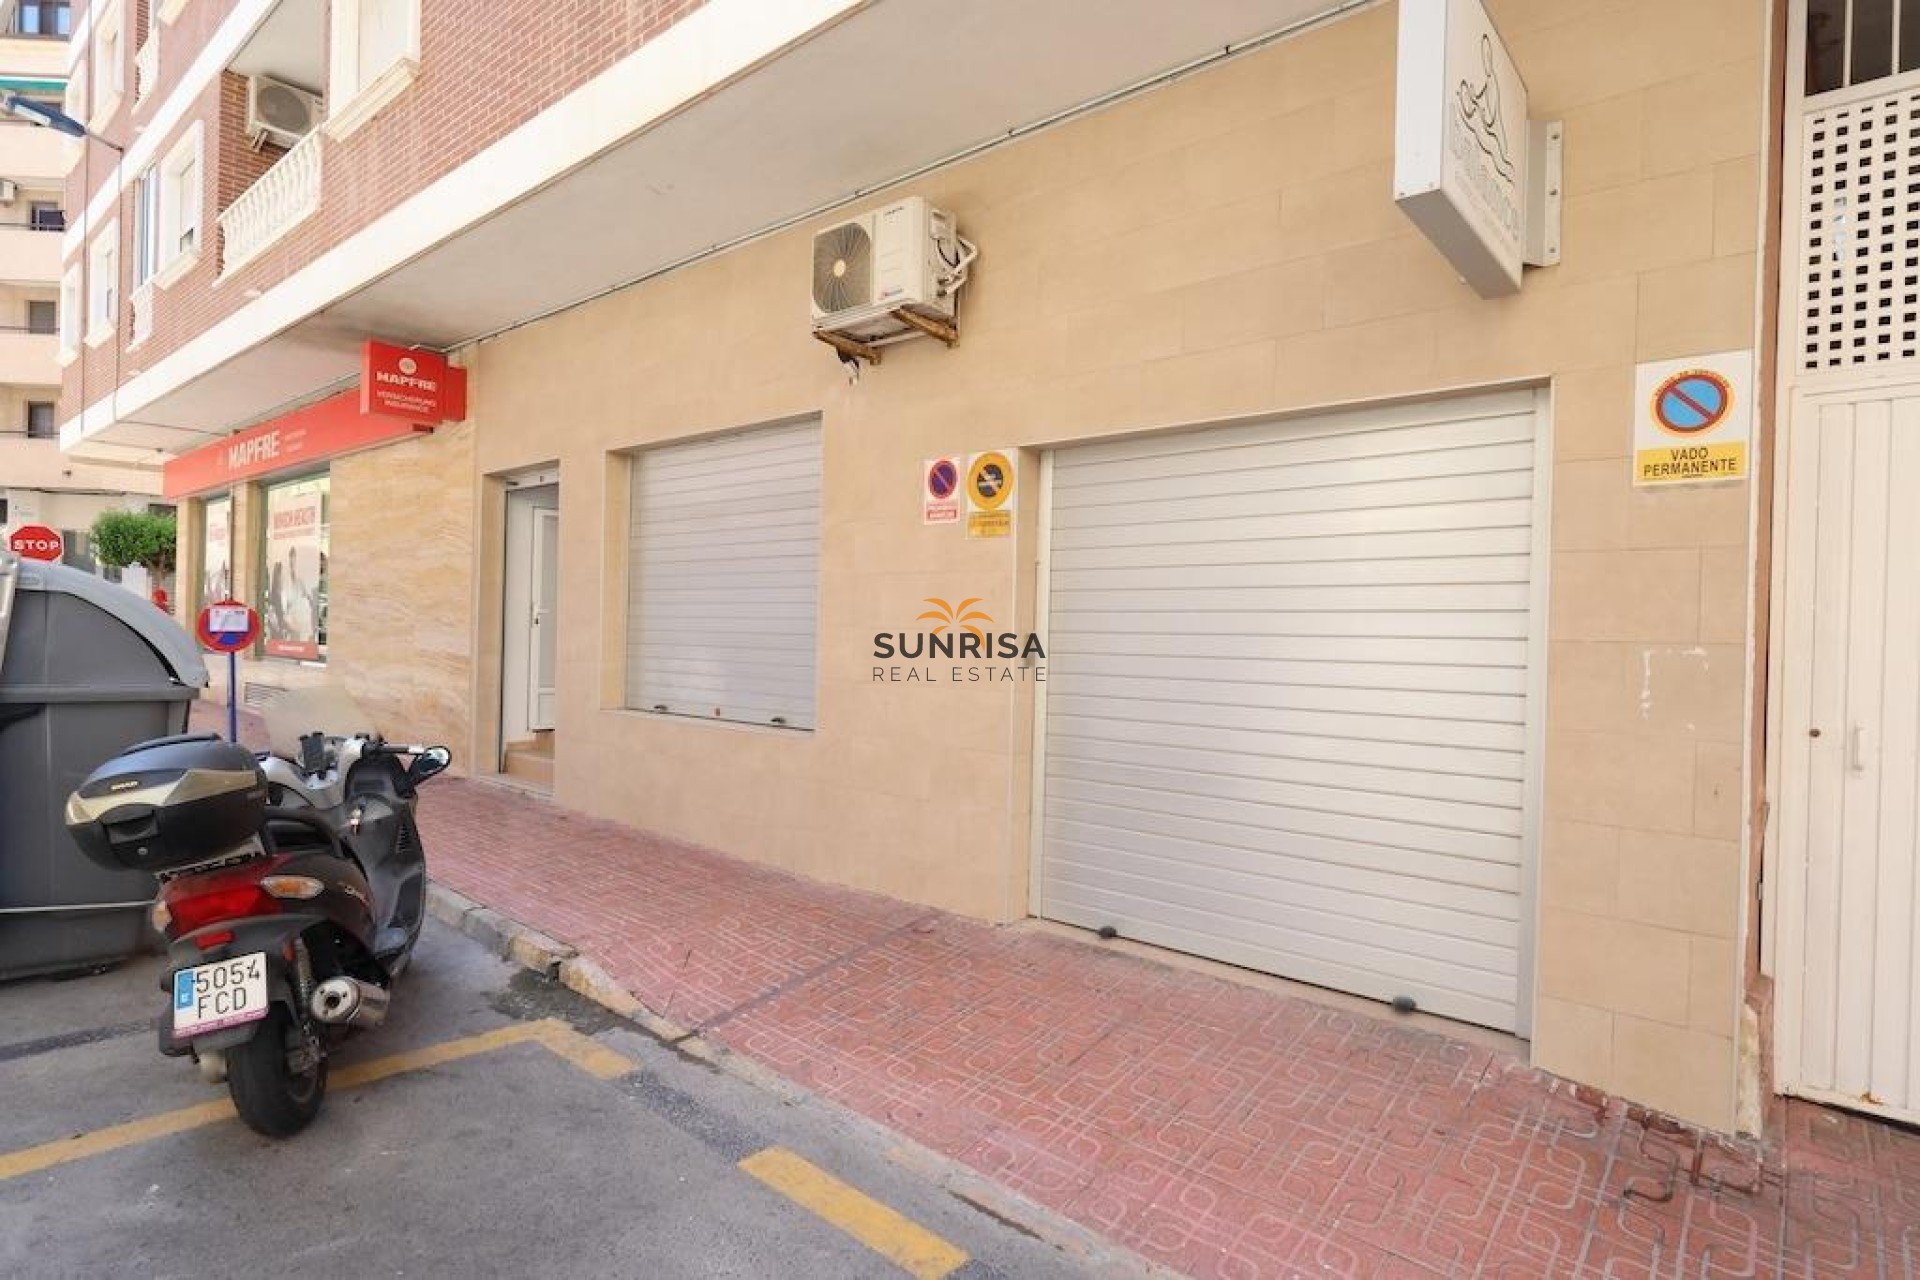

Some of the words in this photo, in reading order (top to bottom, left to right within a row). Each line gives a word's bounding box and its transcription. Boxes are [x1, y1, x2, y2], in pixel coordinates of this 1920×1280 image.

[377, 371, 436, 392] MAPFRE
[228, 430, 280, 470] MAPFRE
[1670, 447, 1709, 461] VADO
[1643, 457, 1737, 477] PERMANENTE
[14, 539, 59, 551] STOP
[196, 959, 260, 993] 5054
[198, 987, 247, 1019] FCD
